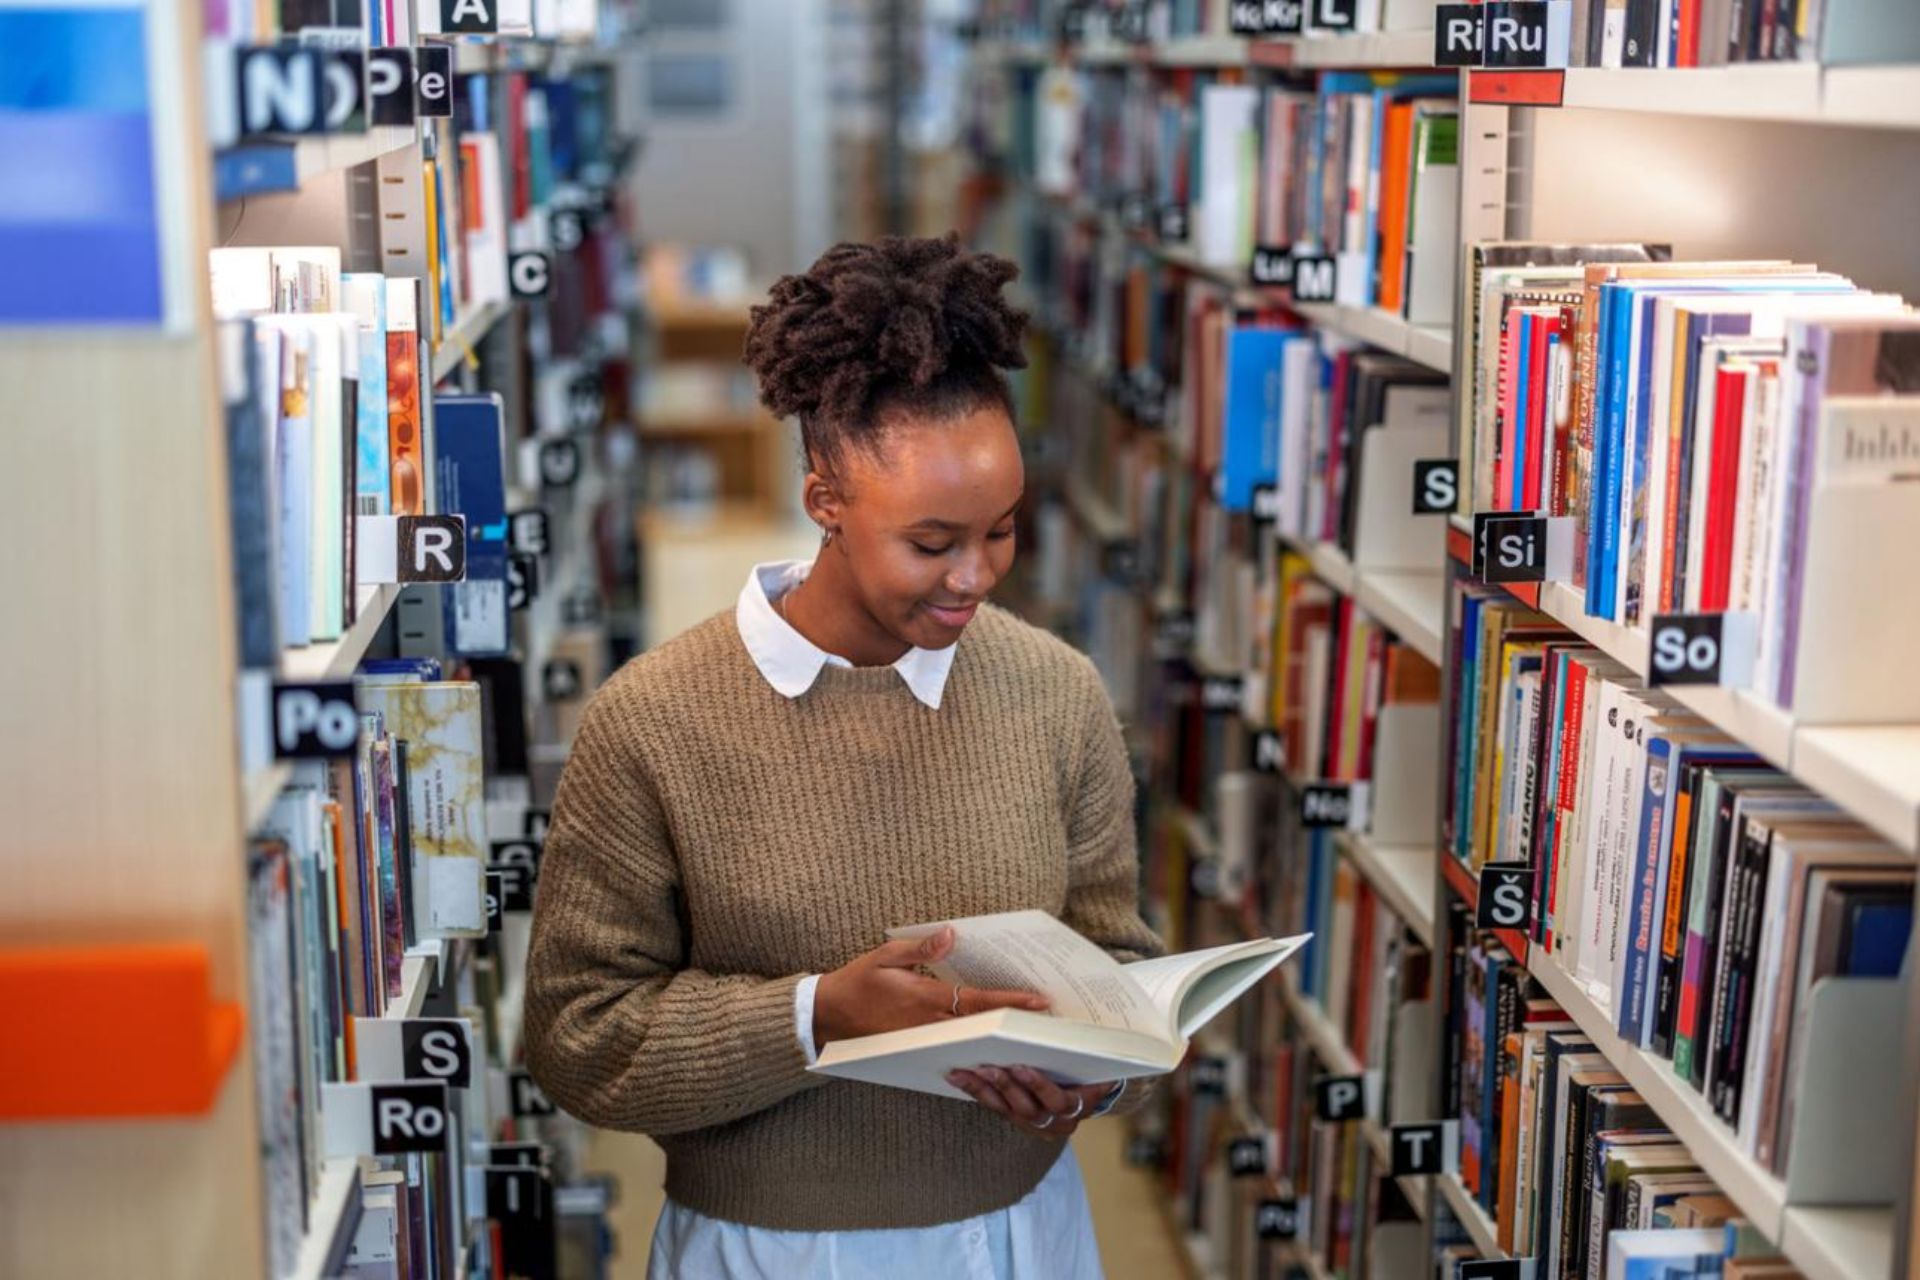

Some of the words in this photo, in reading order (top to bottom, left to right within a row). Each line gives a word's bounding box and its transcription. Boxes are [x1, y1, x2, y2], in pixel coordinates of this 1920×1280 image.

[451, 0, 490, 24] A
[1321, 0, 1349, 24] L
[1448, 18, 1483, 51] Ri
[1491, 18, 1542, 52] Ru
[244, 52, 316, 132] N
[412, 66, 446, 99] e
[512, 253, 548, 294] C
[1297, 260, 1332, 299] M
[1424, 468, 1456, 508] S
[415, 527, 453, 572] R
[1499, 534, 1536, 567] Si
[1653, 627, 1719, 671] So
[276, 689, 359, 752] Po
[1491, 875, 1525, 924] Š
[421, 1030, 459, 1077] S
[1329, 1084, 1357, 1117] P
[379, 1101, 444, 1139] Ro
[1401, 1132, 1434, 1168] T
